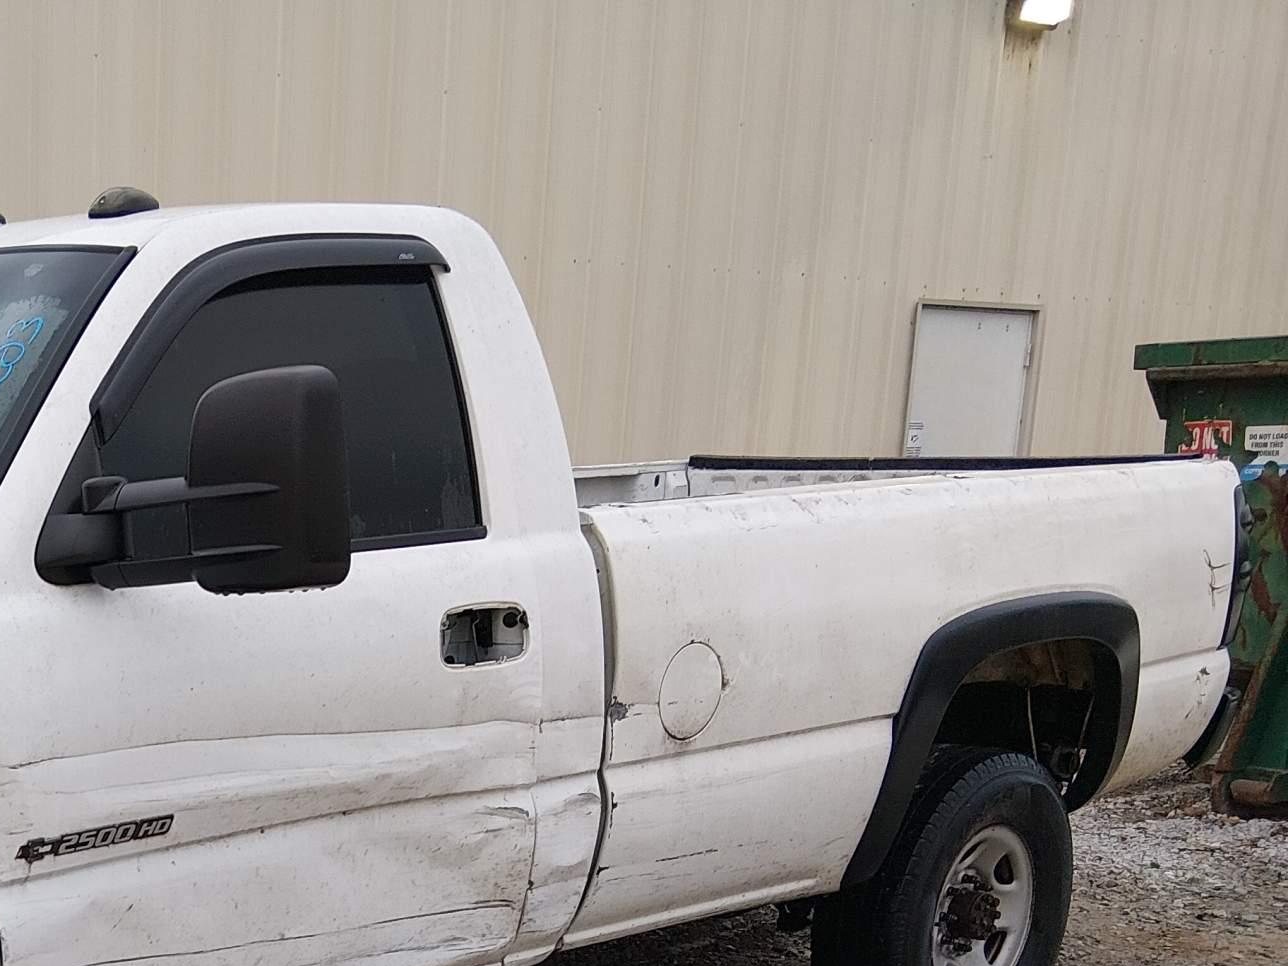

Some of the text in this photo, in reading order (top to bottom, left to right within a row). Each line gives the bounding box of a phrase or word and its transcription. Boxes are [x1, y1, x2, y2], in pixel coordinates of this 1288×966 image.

[1259, 432, 1272, 441] NOT
[1250, 441, 1284, 449] FROM THIS
[59, 818, 172, 853] 2500 HD
